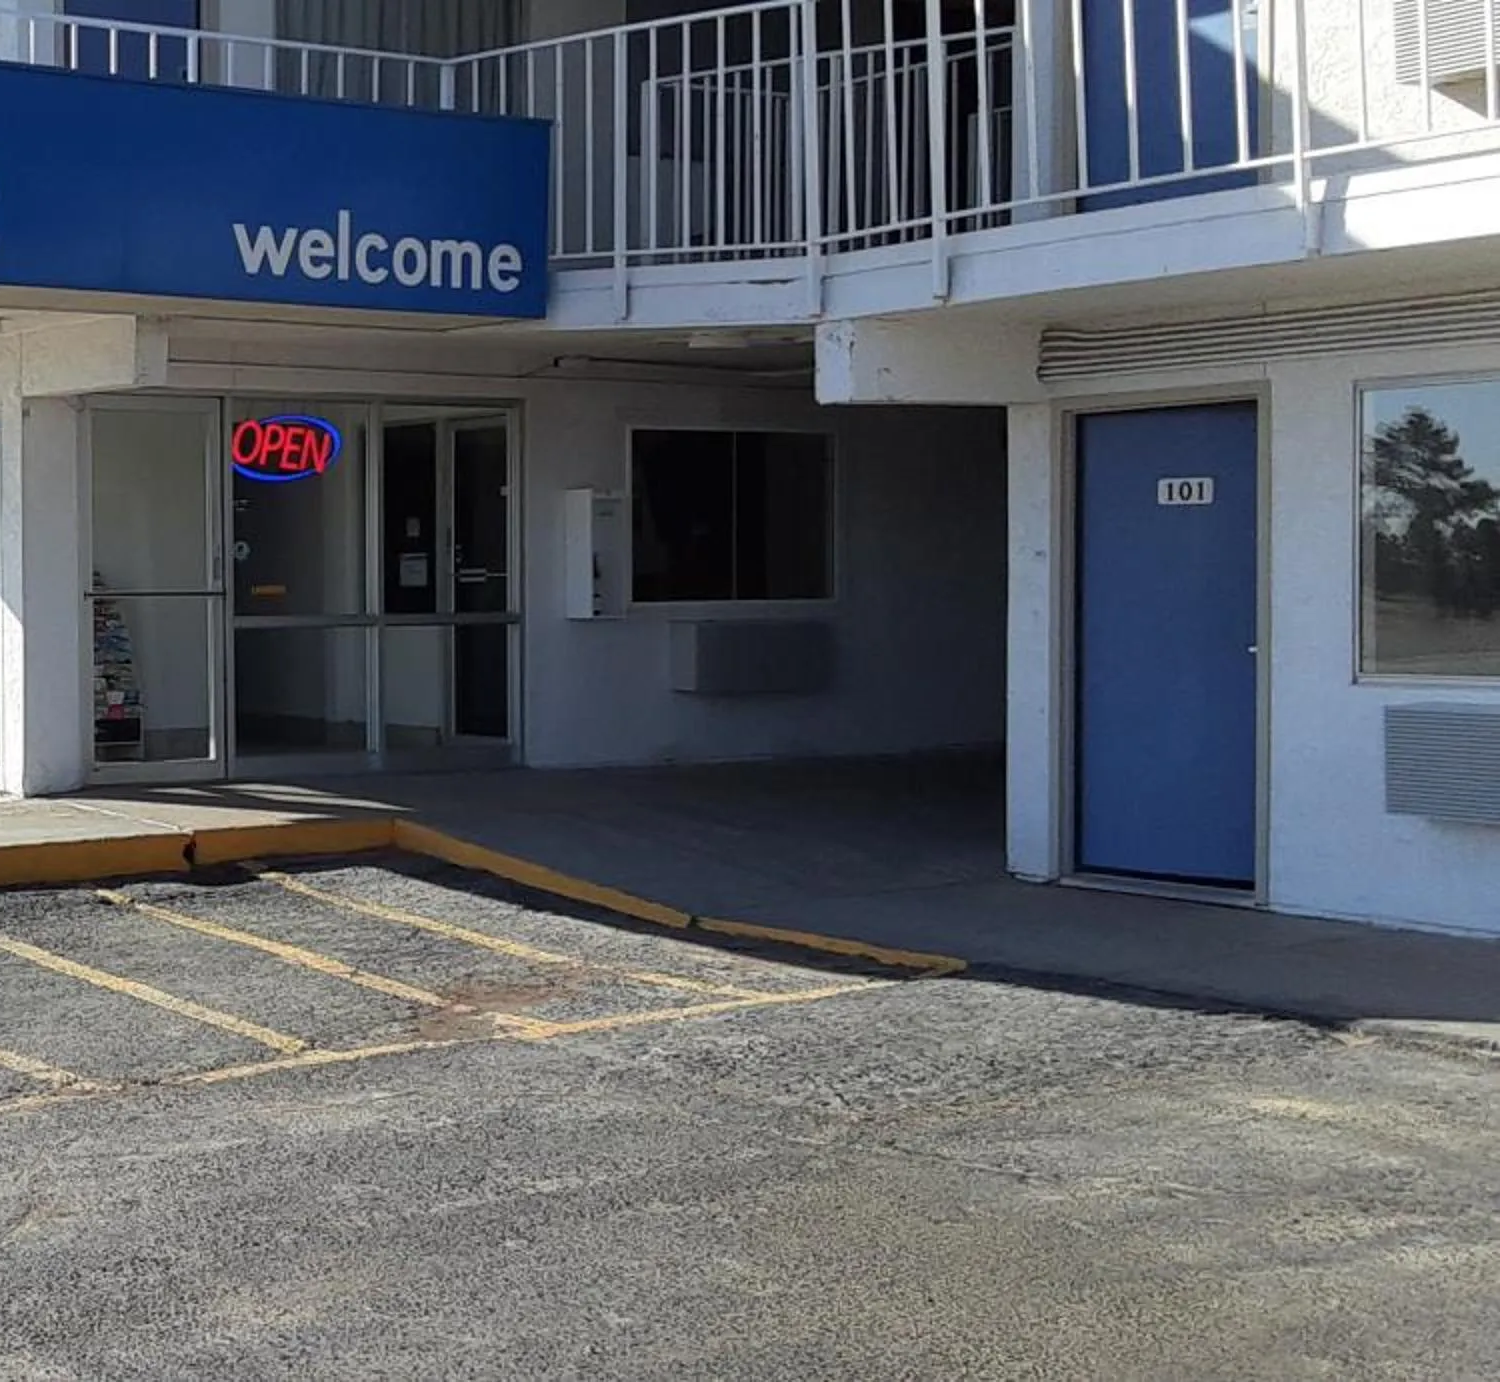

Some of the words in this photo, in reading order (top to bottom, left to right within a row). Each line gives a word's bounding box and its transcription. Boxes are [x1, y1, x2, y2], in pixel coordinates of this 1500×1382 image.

[232, 209, 523, 292] welcome
[232, 420, 332, 473] OPEN
[1164, 481, 1206, 501] 101
